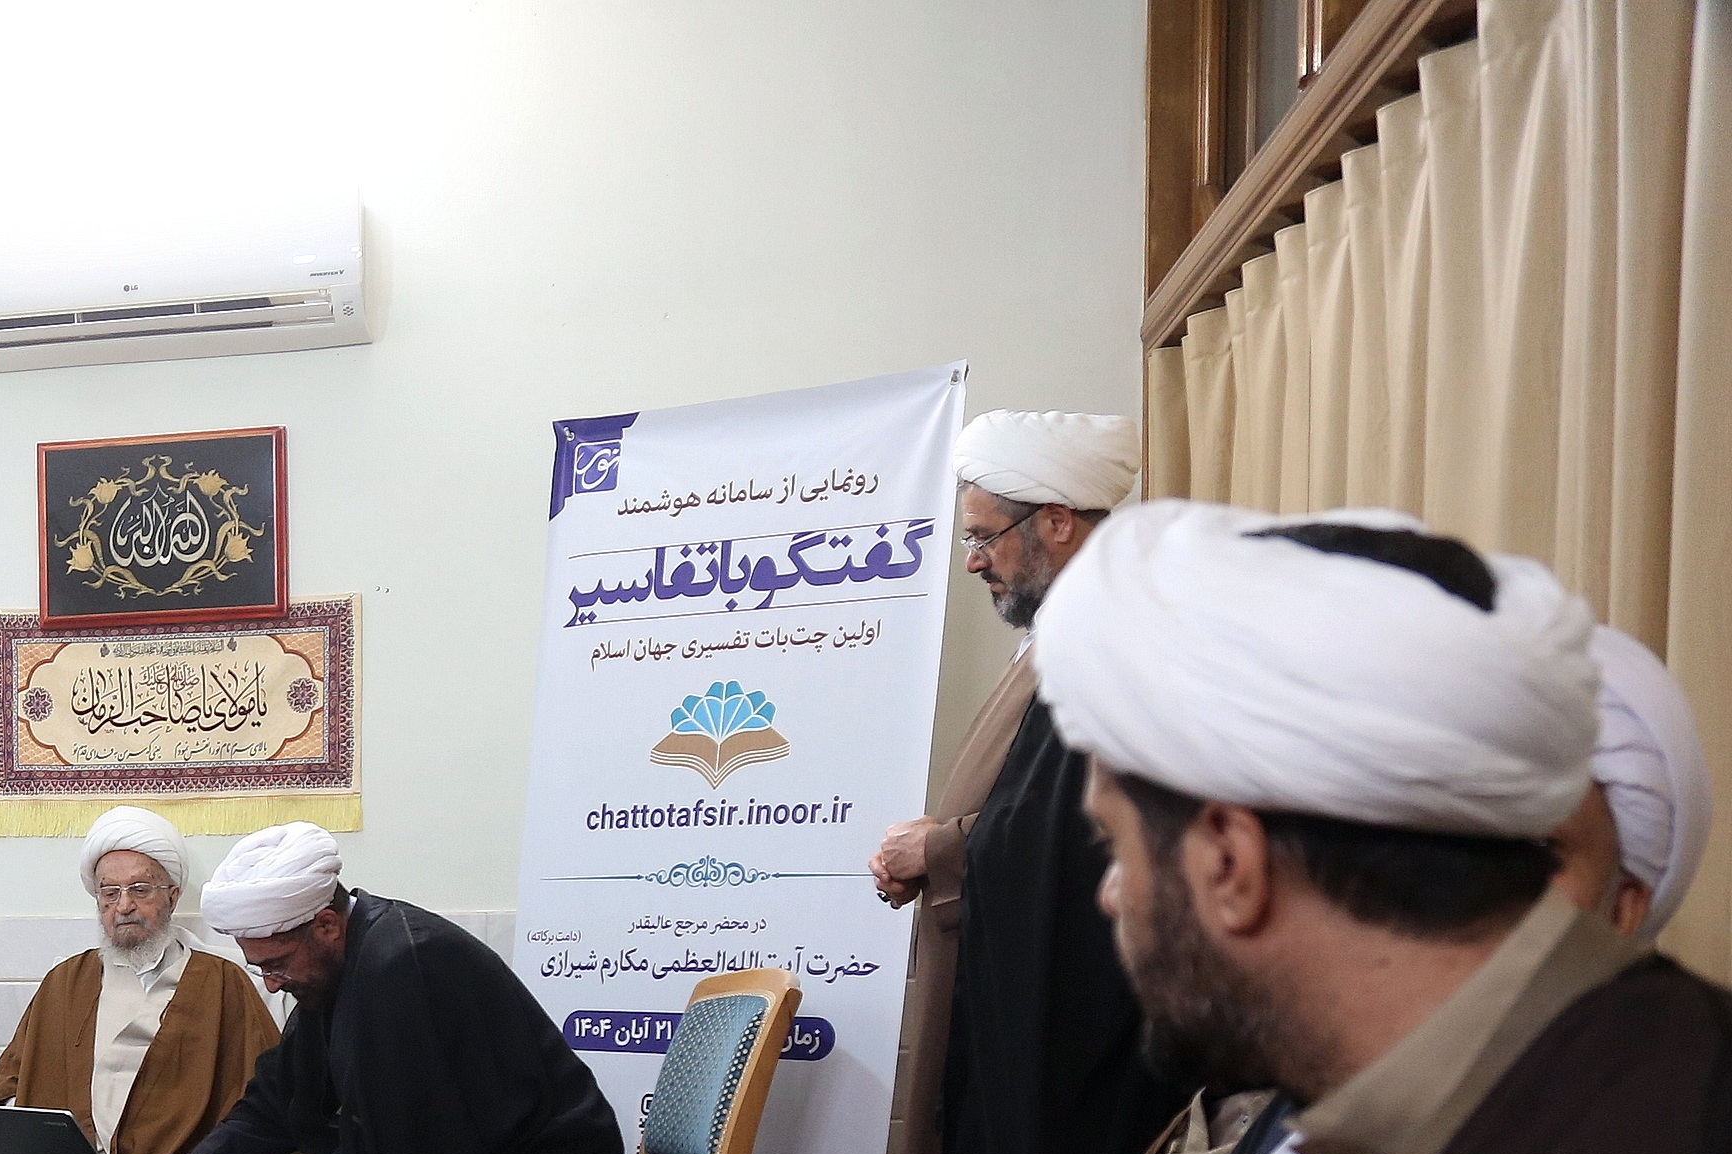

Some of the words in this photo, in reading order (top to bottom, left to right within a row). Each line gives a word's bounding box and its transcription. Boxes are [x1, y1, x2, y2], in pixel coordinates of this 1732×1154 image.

[707, 478, 773, 505] سامانه
[776, 473, 796, 504] از
[800, 467, 879, 502] رونمایی
[617, 489, 702, 517] هوشمند
[718, 539, 752, 613] با
[750, 518, 936, 610] گفتگو
[563, 540, 720, 628] تفاسیر
[681, 629, 752, 659] تفسیری
[832, 618, 883, 649] اولین
[590, 638, 631, 672] اسلام
[633, 637, 679, 662] جهان
[586, 794, 853, 831] chattotafsir.inoor.ir
[627, 914, 673, 935] عالیقدر
[674, 920, 709, 937] مرجع
[709, 916, 750, 935] محضر
[751, 916, 768, 935] در
[540, 949, 599, 979] شیرازی
[599, 948, 650, 985] مکارم
[805, 953, 882, 984] حضرت
[573, 1017, 613, 1038] ۱۴۰۴
[614, 1016, 651, 1046] آبان
